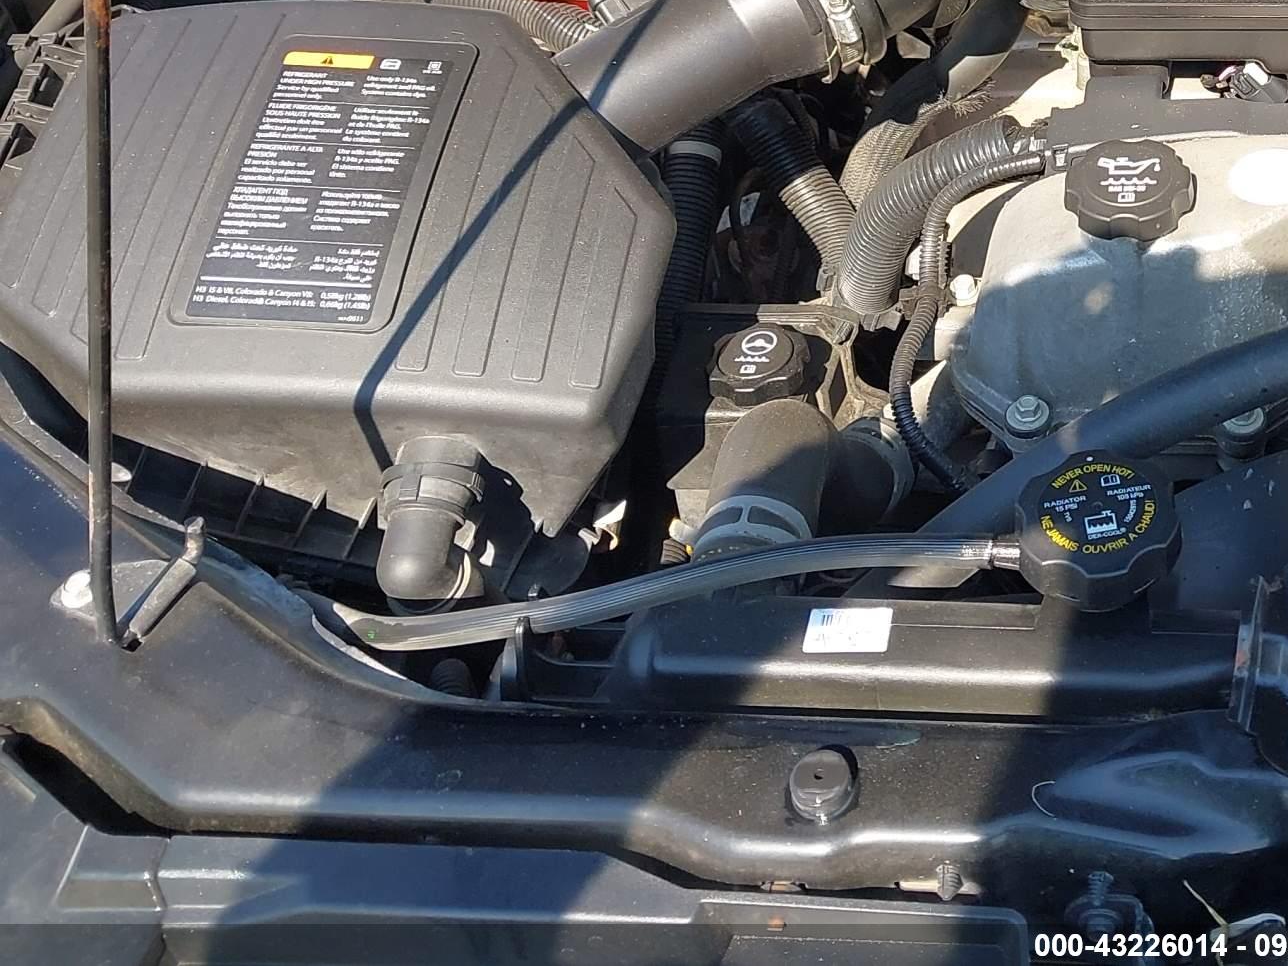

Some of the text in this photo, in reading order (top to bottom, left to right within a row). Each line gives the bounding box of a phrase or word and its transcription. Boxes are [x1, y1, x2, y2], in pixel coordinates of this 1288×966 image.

[250, 143, 300, 152] REFRIGERANTE
[235, 287, 268, 296] Colorado
[275, 290, 302, 299] Canyon
[265, 299, 292, 307] Canyon
[1052, 464, 1135, 489] NEVER OPEN HOT!
[1107, 485, 1152, 496] RADIATEUR
[1044, 495, 1087, 508] RADIATOR
[1065, 503, 1078, 511] PSI
[1040, 515, 1054, 530] NE
[1135, 500, 1156, 534] CHAUD!
[1046, 528, 1080, 552] JAMAIS
[1083, 538, 1129, 554] OUVRIR
